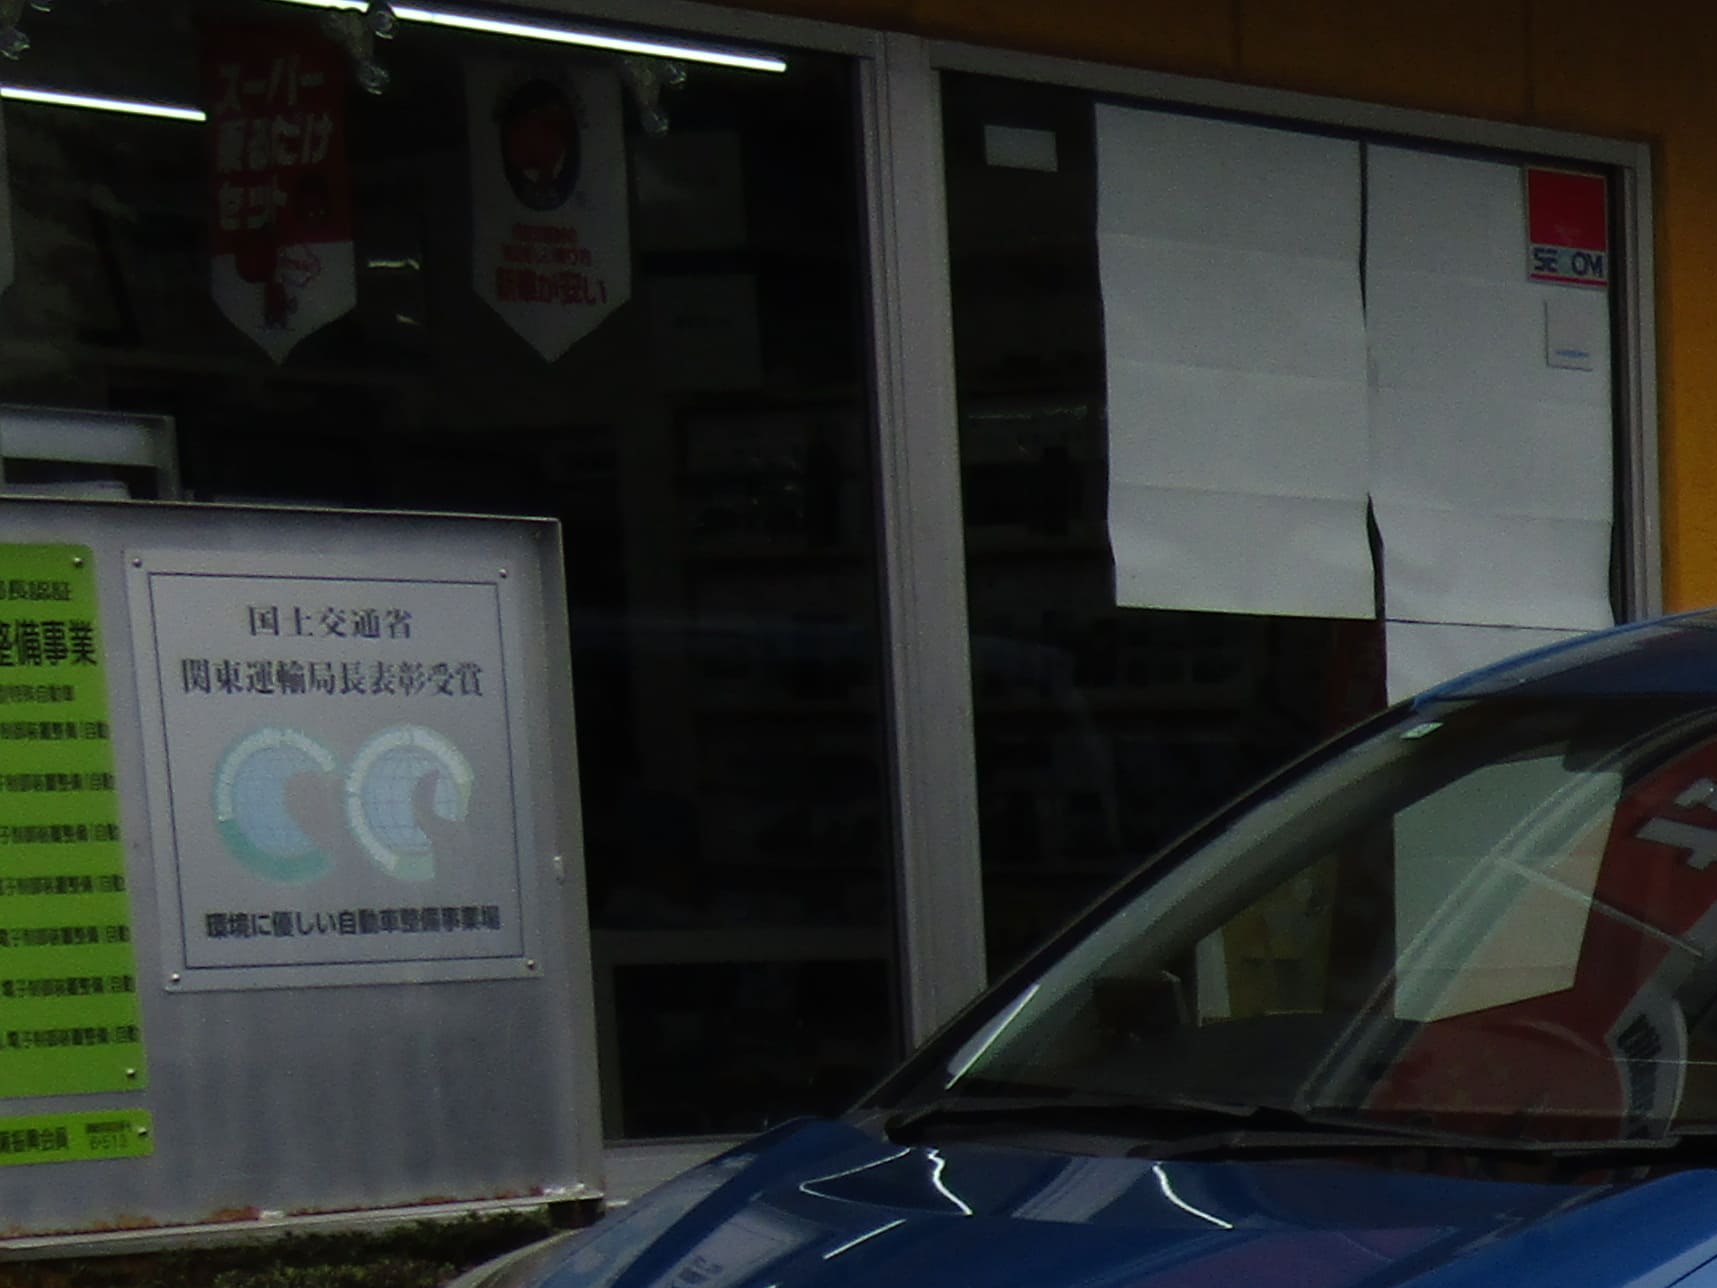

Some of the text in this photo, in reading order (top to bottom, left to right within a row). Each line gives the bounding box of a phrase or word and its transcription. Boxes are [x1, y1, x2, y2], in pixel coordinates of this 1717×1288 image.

[249, 605, 412, 640] 国土交通省
[181, 658, 484, 697] 関東運輸局長表彰受賞
